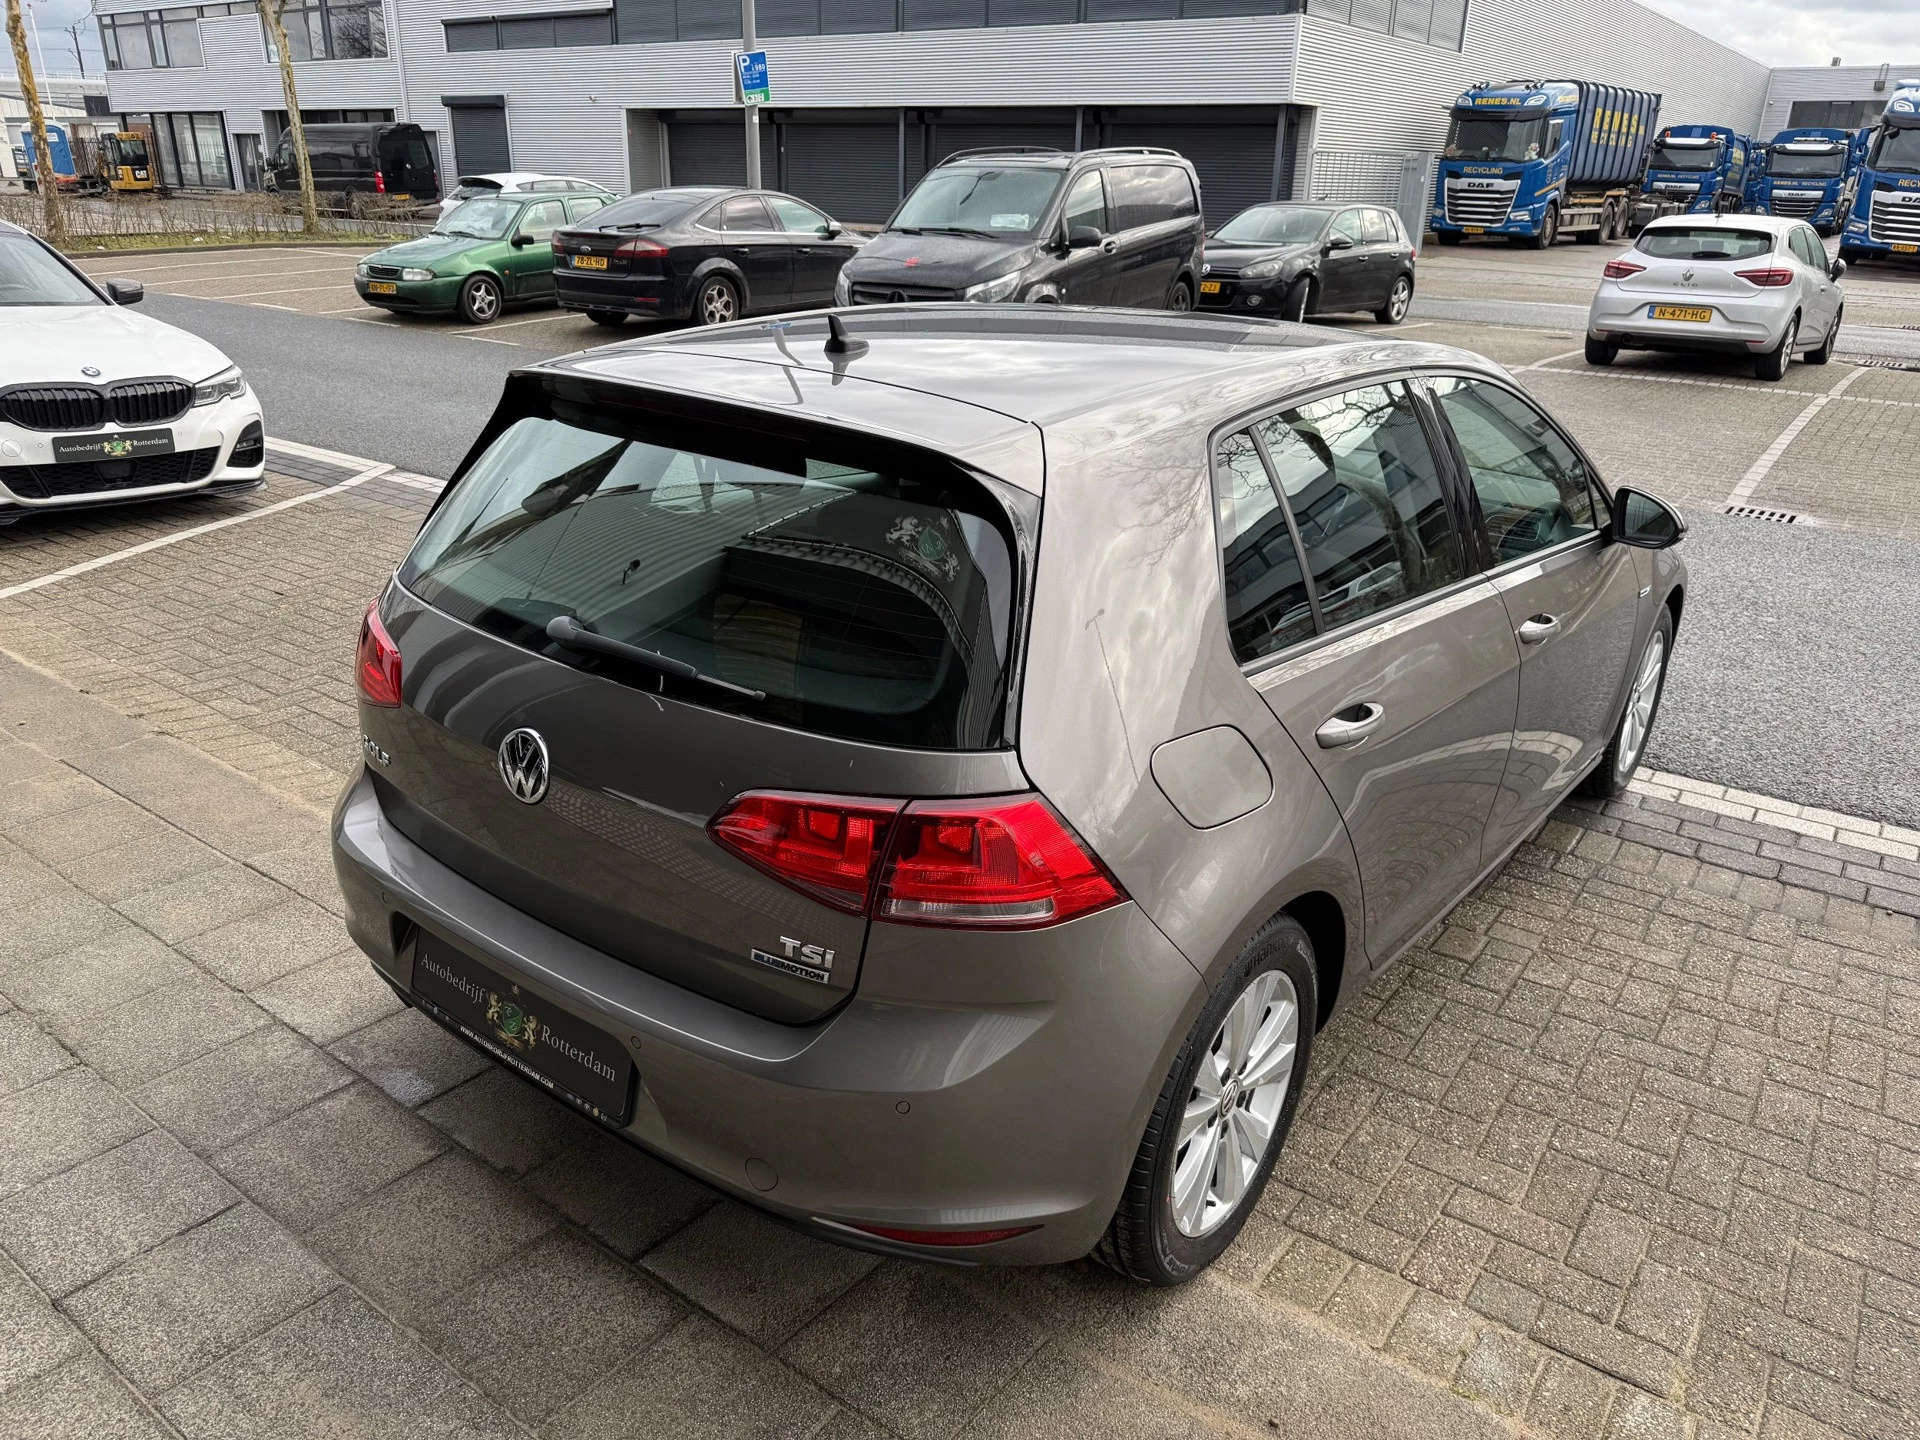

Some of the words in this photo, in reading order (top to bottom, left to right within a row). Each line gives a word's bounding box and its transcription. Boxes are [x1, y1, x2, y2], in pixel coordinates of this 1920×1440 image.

[739, 55, 750, 73] P
[1475, 97, 1522, 105] RENES.NL
[1593, 107, 1638, 134] RENES
[135, 170, 147, 179] CAT
[1463, 166, 1503, 174] RECYCLING
[576, 256, 606, 267] 78-ZL-HD
[1658, 307, 1707, 320] N-471-HG
[59, 443, 102, 453] Autobedrijf
[133, 437, 169, 447] Rotterdam
[780, 935, 835, 969] TSI
[421, 953, 486, 1004] Autobedrijf
[541, 1024, 616, 1082] Rotterdam
